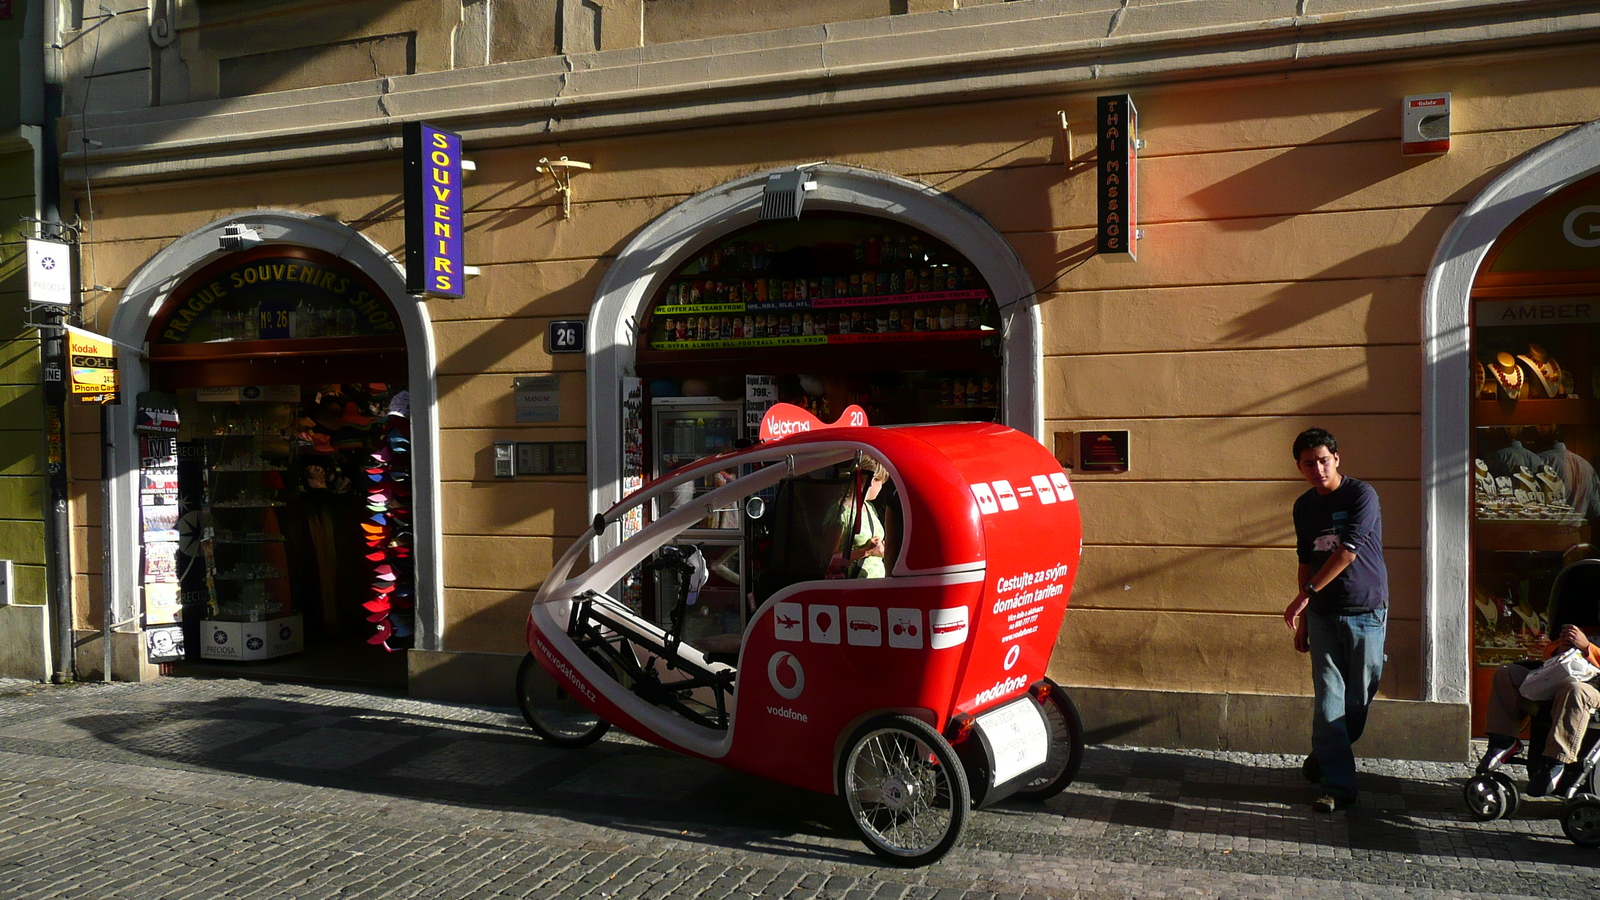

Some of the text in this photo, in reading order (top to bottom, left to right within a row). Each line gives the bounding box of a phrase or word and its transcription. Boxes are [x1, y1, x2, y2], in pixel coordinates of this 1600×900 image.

[1106, 101, 1120, 249] THAI MASSAGE
[431, 133, 454, 290] SOUVENIRS
[163, 264, 397, 342] PRAGUE SOUVENIRS SHOP
[1501, 304, 1591, 320] AMBER
[276, 309, 288, 328] 26
[557, 328, 576, 346] 26
[738, 339, 773, 347] FOOTBALL
[72, 343, 98, 354] Kodak
[72, 355, 115, 368] GOLD
[100, 384, 119, 392] Card
[850, 411, 863, 426] 20
[997, 562, 1068, 594] Cestujte za svým
[993, 583, 1064, 615] domácím tarifem
[206, 645, 236, 654] PRECIOSA
[536, 637, 597, 703] www.vodafone.cz
[975, 674, 1028, 706] vodafone
[766, 705, 809, 723] vodafone
